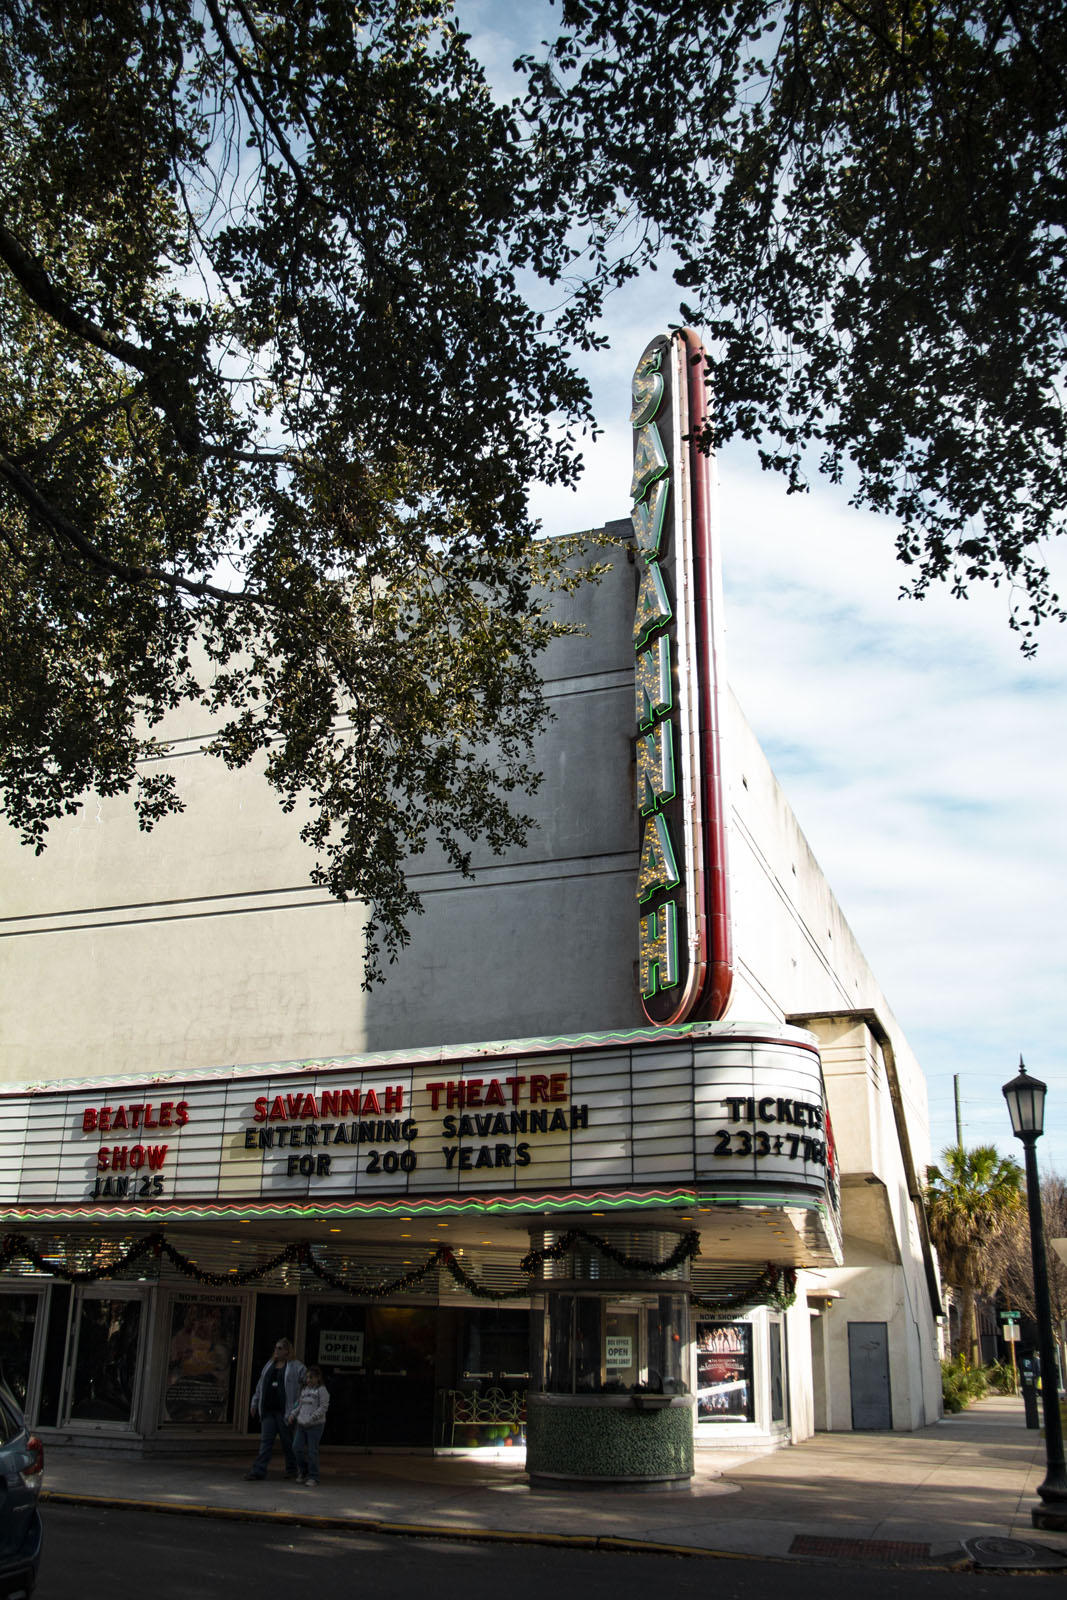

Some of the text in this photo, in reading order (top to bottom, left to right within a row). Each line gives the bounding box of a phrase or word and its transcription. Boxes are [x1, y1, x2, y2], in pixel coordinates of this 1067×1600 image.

[629, 347, 680, 1000] SAVANNAH
[252, 1073, 568, 1123] SAVANNAH THEATRE
[725, 1096, 824, 1130] TICKETS
[82, 1101, 190, 1133] BEATLES
[244, 1104, 589, 1149] ENTERTAINING SAVANNAH
[96, 1144, 168, 1172] SHOW
[287, 1142, 531, 1177] FOR 200 YEARS
[89, 1174, 165, 1198] JAN 25
[199, 1294, 238, 1304] SHOWING
[699, 1313, 715, 1321] NOW
[325, 1343, 357, 1353] OPEN
[608, 1348, 628, 1356] OPEN
